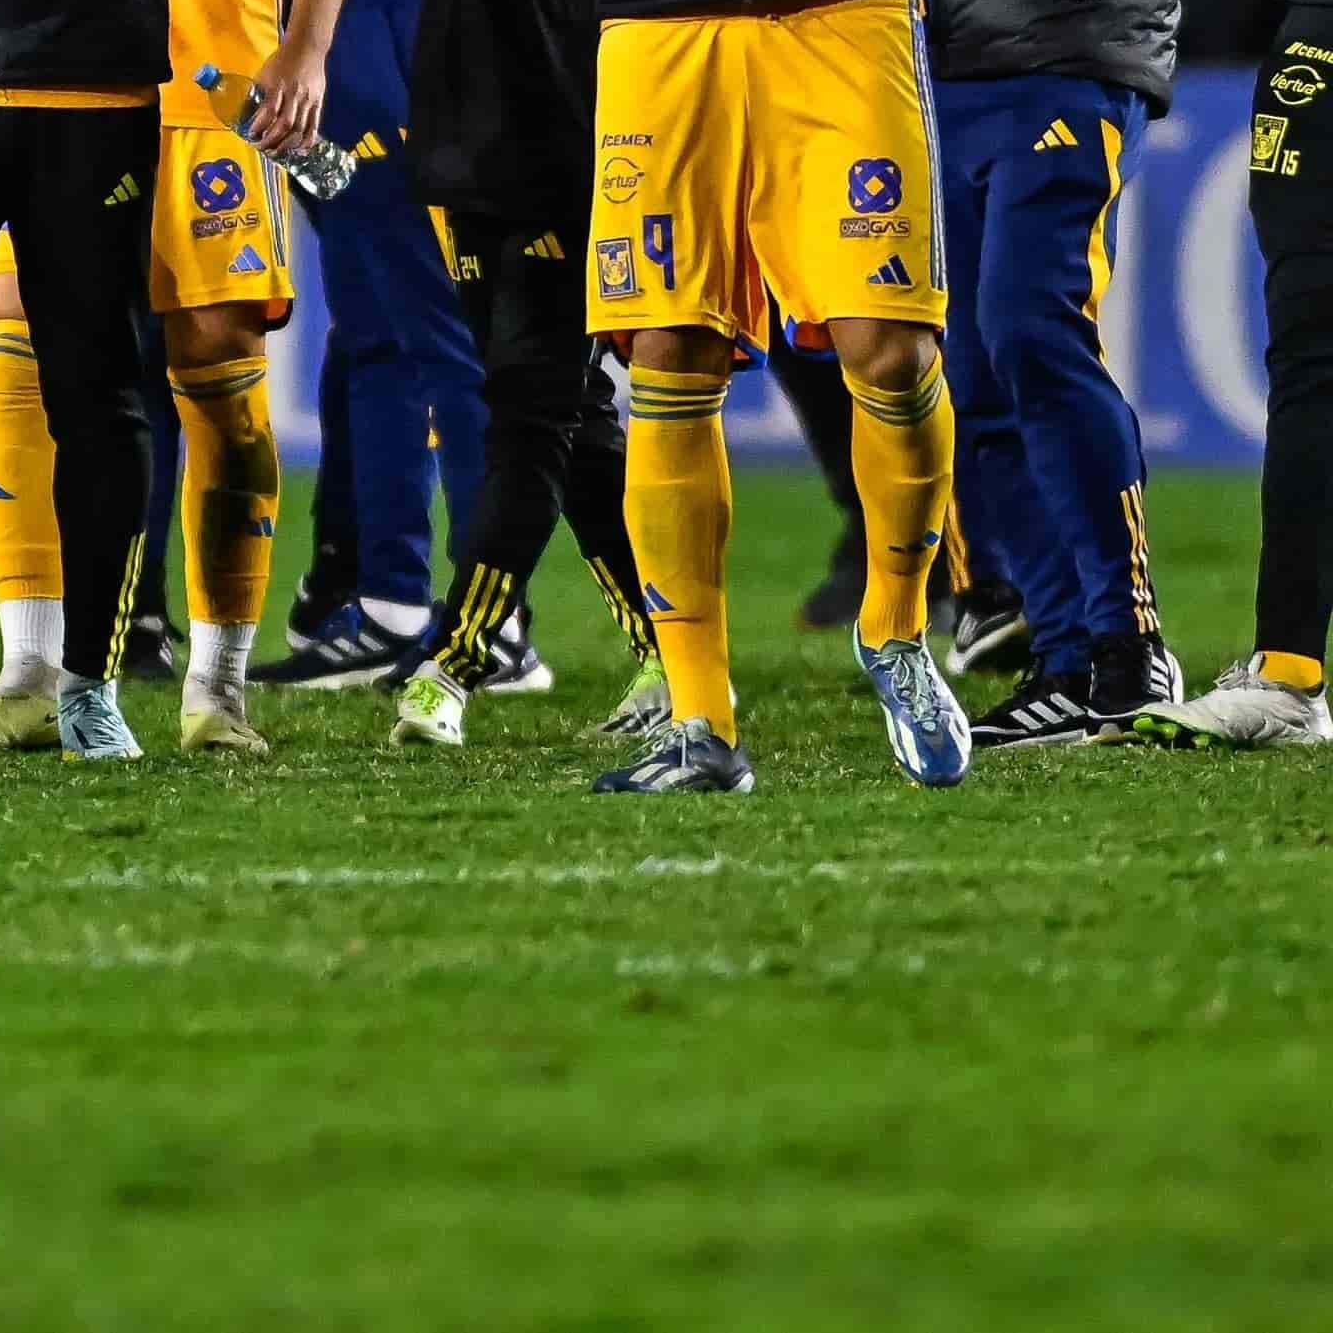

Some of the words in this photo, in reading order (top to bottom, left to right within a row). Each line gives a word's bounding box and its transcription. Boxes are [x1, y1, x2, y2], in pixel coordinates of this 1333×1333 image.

[1297, 45, 1333, 65] CEME
[1270, 72, 1316, 95] Vertua
[604, 134, 653, 147] CEMEX
[1281, 149, 1301, 176] 15
[871, 221, 909, 234] GAS
[460, 255, 480, 280] 24
